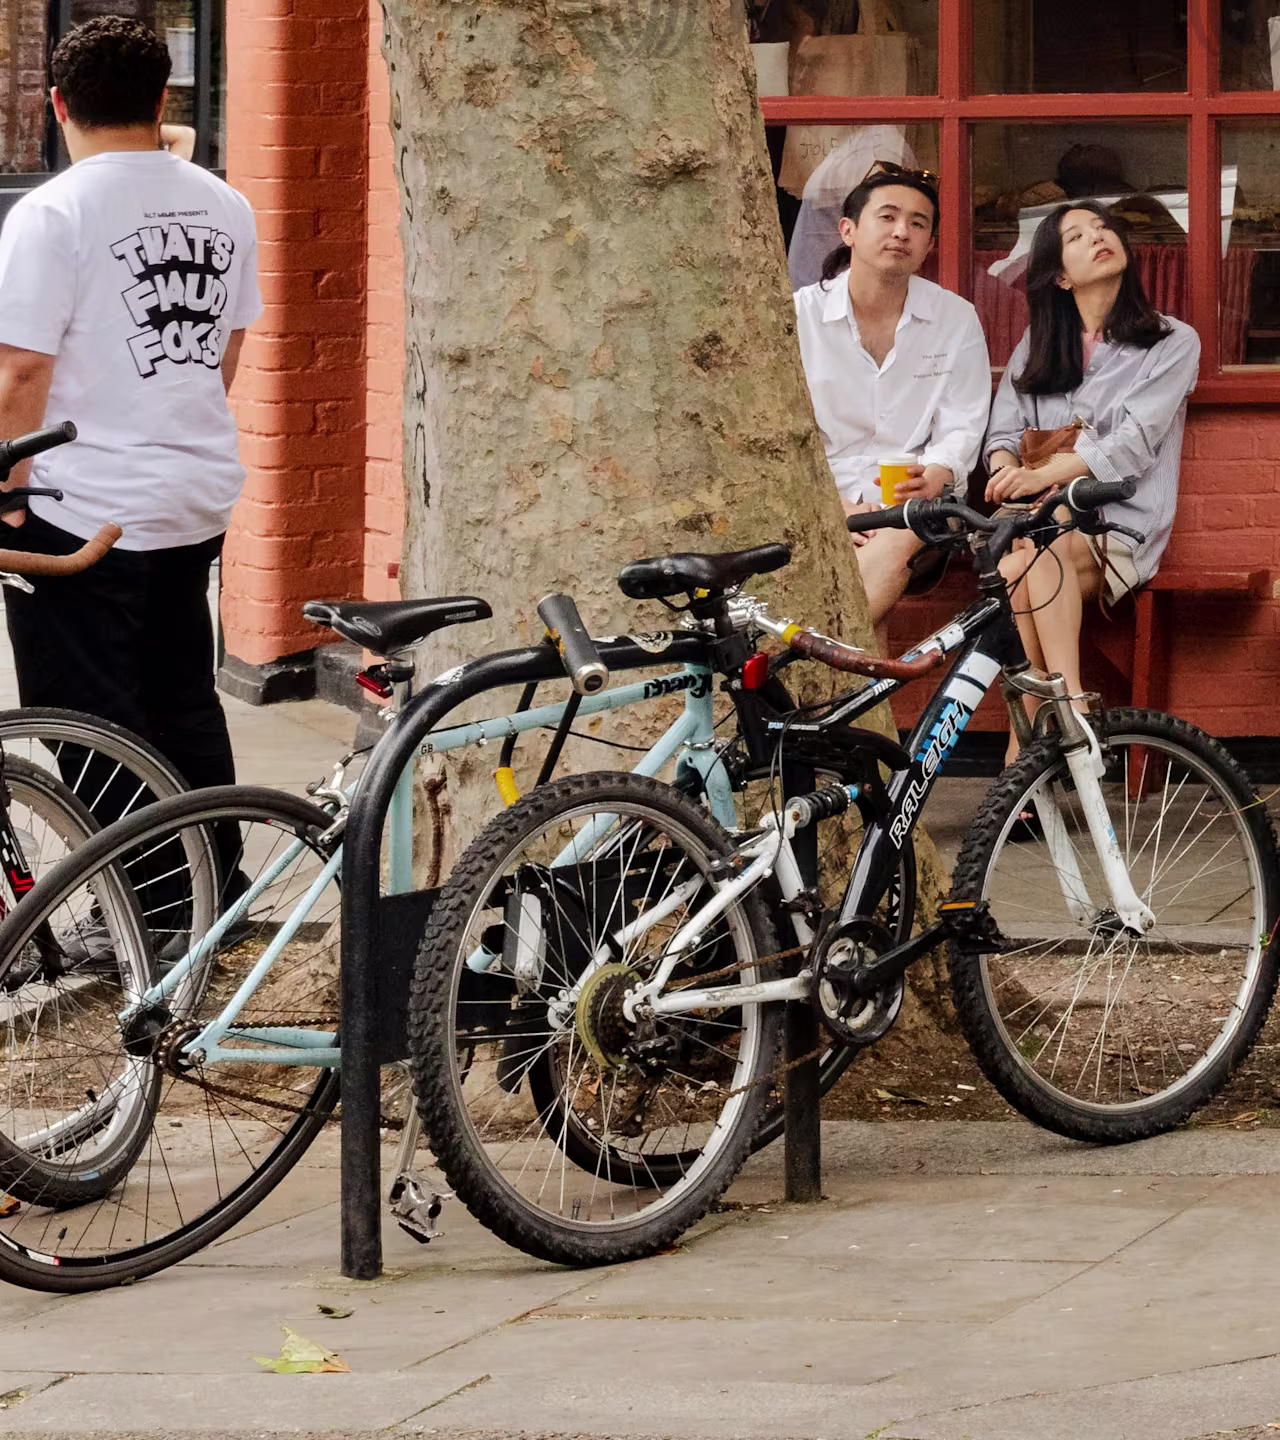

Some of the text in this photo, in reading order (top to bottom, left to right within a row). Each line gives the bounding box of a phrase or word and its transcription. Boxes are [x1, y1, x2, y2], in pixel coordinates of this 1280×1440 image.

[110, 222, 235, 278] THAT'S
[421, 743, 434, 755] GB
[888, 699, 966, 851] RALEIGH
